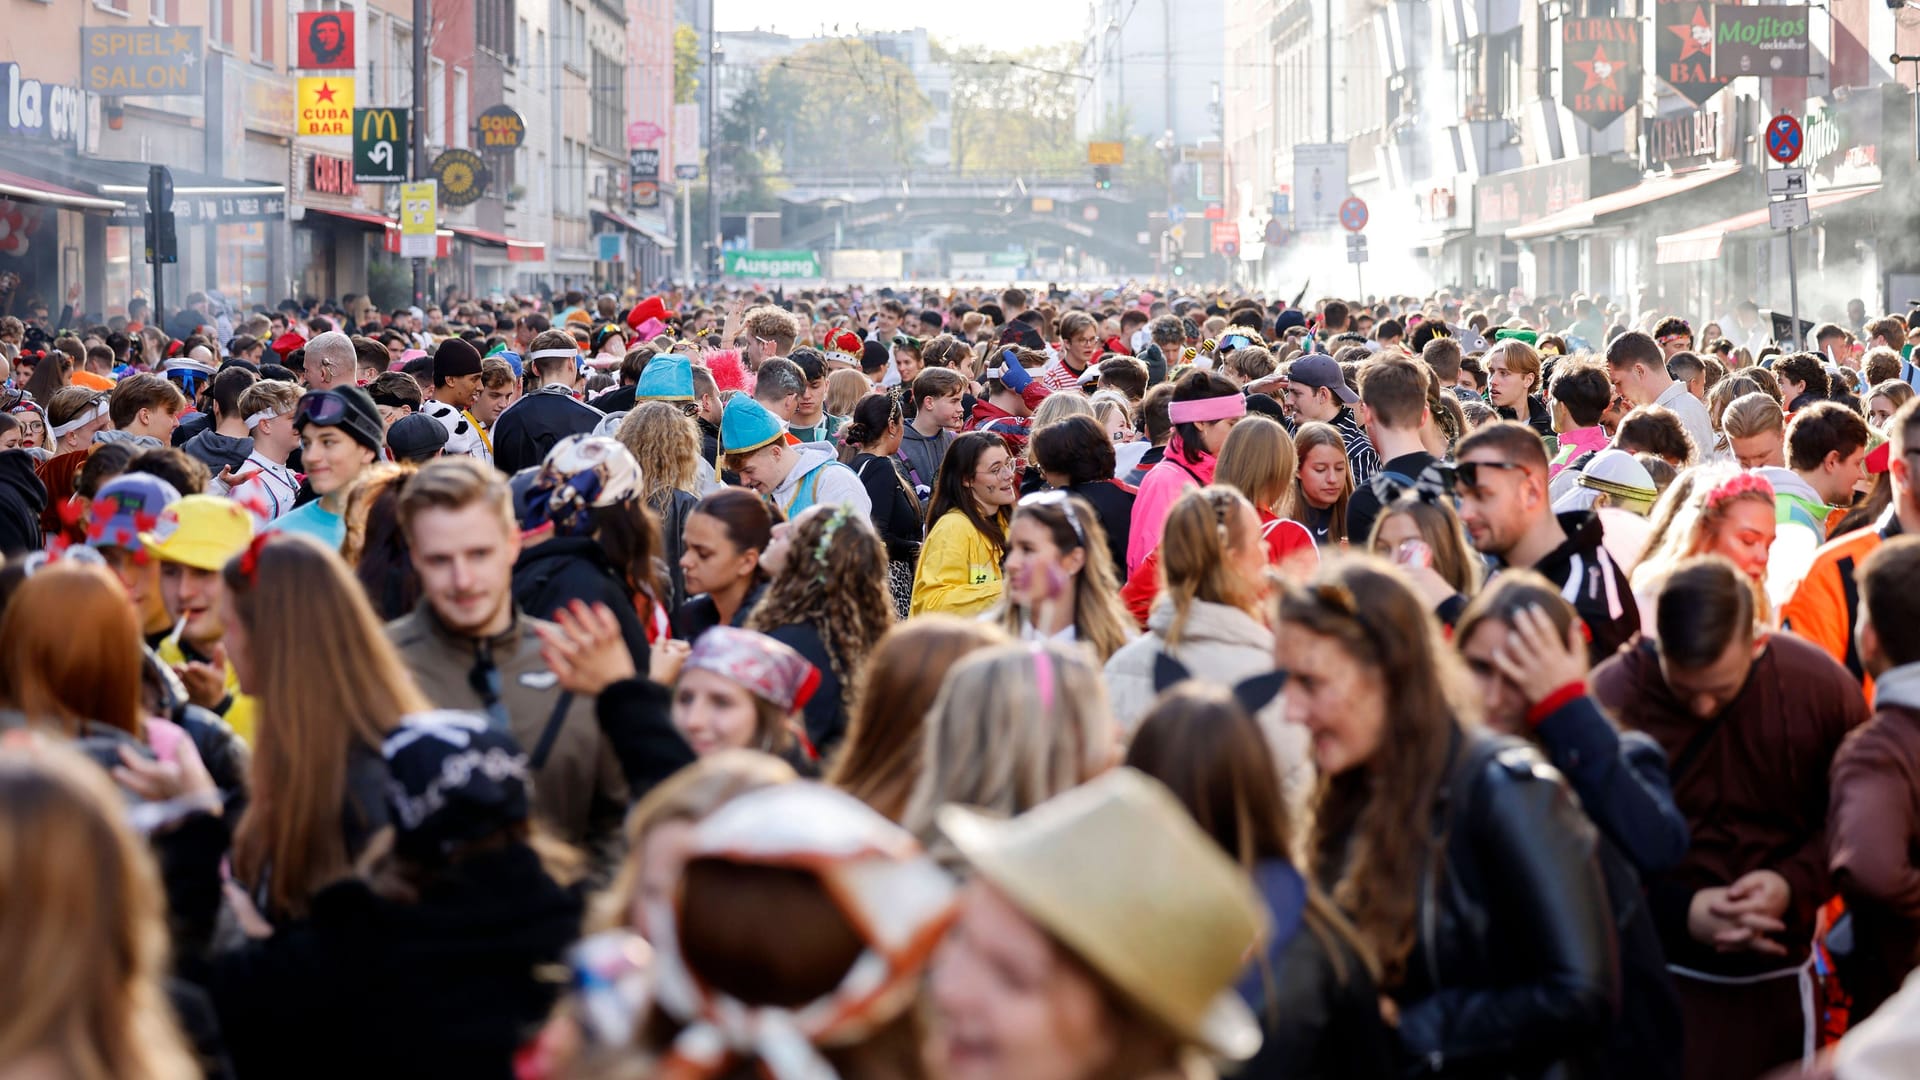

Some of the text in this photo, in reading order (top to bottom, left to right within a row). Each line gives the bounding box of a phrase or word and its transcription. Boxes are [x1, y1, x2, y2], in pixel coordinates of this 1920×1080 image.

[1563, 19, 1638, 44] CUBANA
[1717, 16, 1805, 46] Mojitos
[90, 32, 171, 57] SPIEL
[90, 65, 188, 89] SALON
[1670, 63, 1729, 84] BA
[9, 63, 43, 128] la
[1573, 94, 1627, 112] BAR
[303, 108, 350, 120] CUBA
[481, 115, 523, 131] SOUL
[309, 122, 344, 134] BAR
[485, 130, 517, 146] BAR
[735, 257, 813, 277] Ausgang
